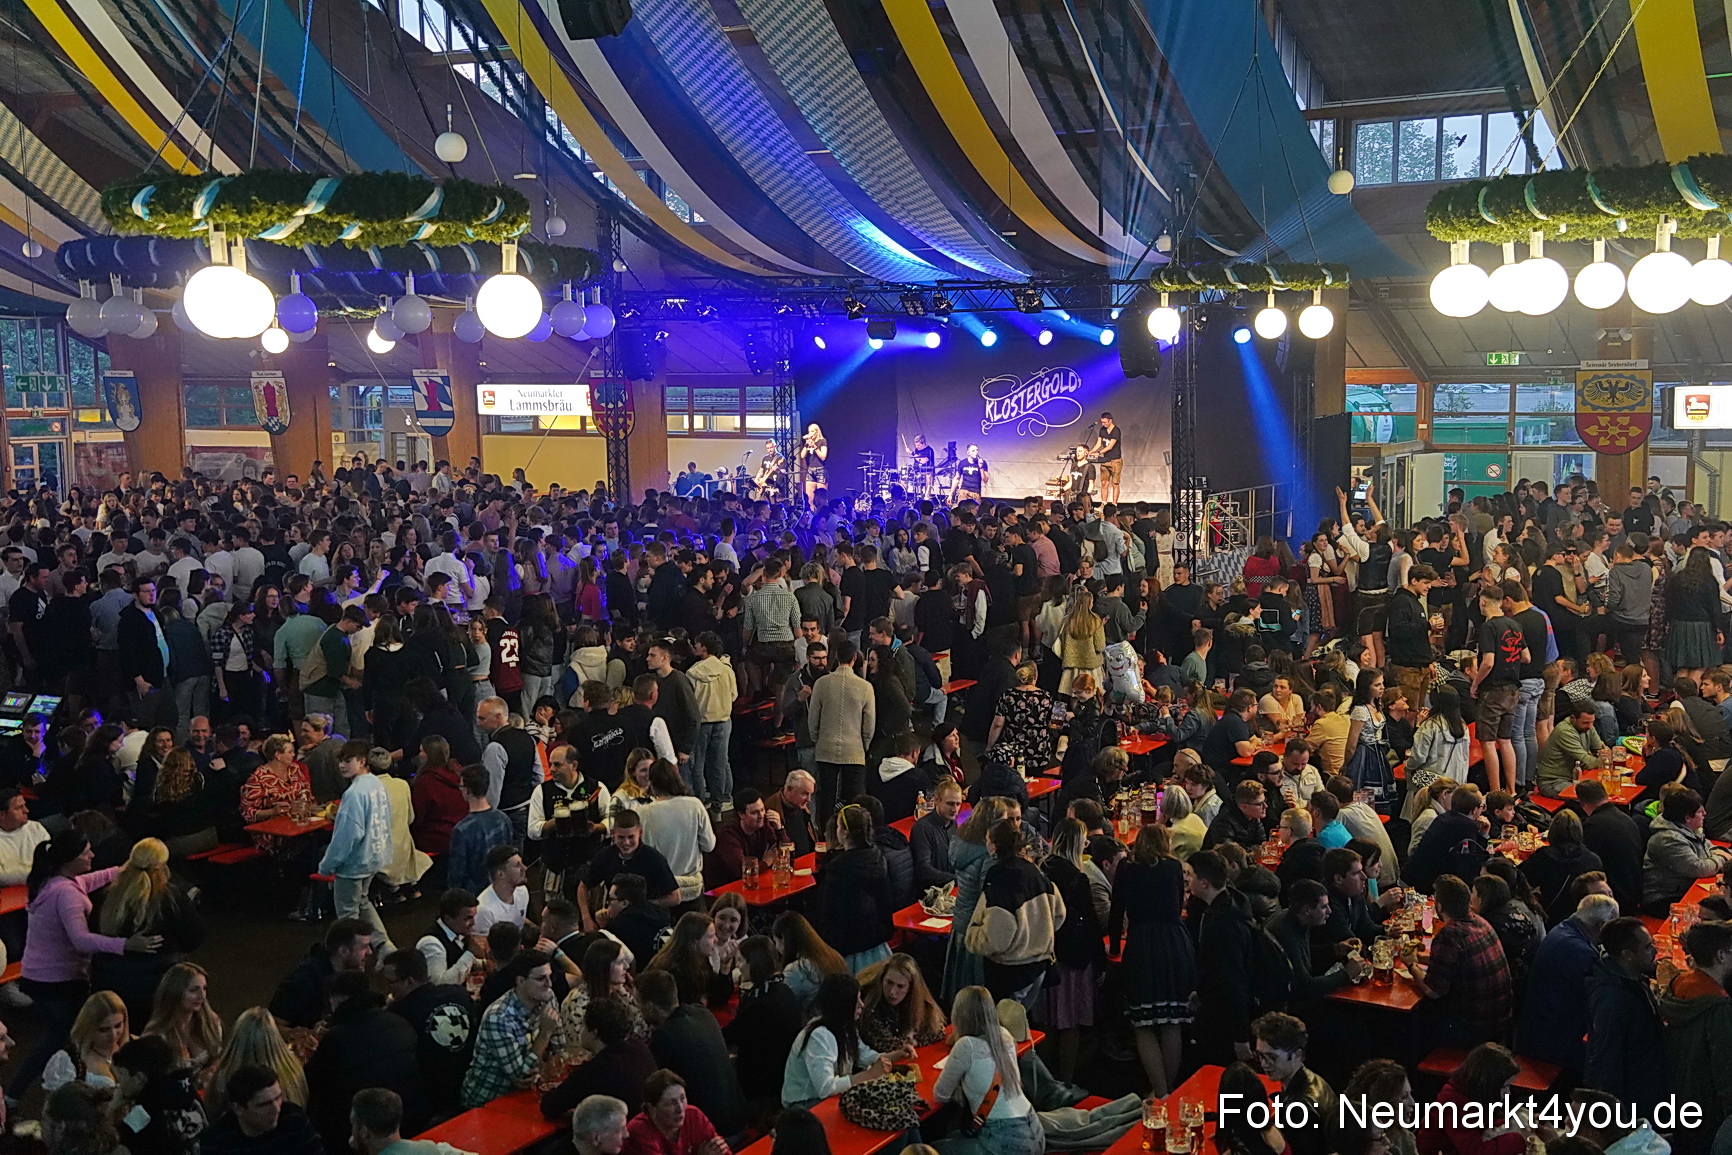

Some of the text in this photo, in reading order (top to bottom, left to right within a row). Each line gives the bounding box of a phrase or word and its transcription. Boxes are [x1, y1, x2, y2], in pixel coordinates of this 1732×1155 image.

[517, 389, 563, 398] Neumarkter
[986, 372, 1077, 422] KLOSTERGOLD
[509, 399, 572, 412] Lammsbräu
[499, 638, 519, 663] 23
